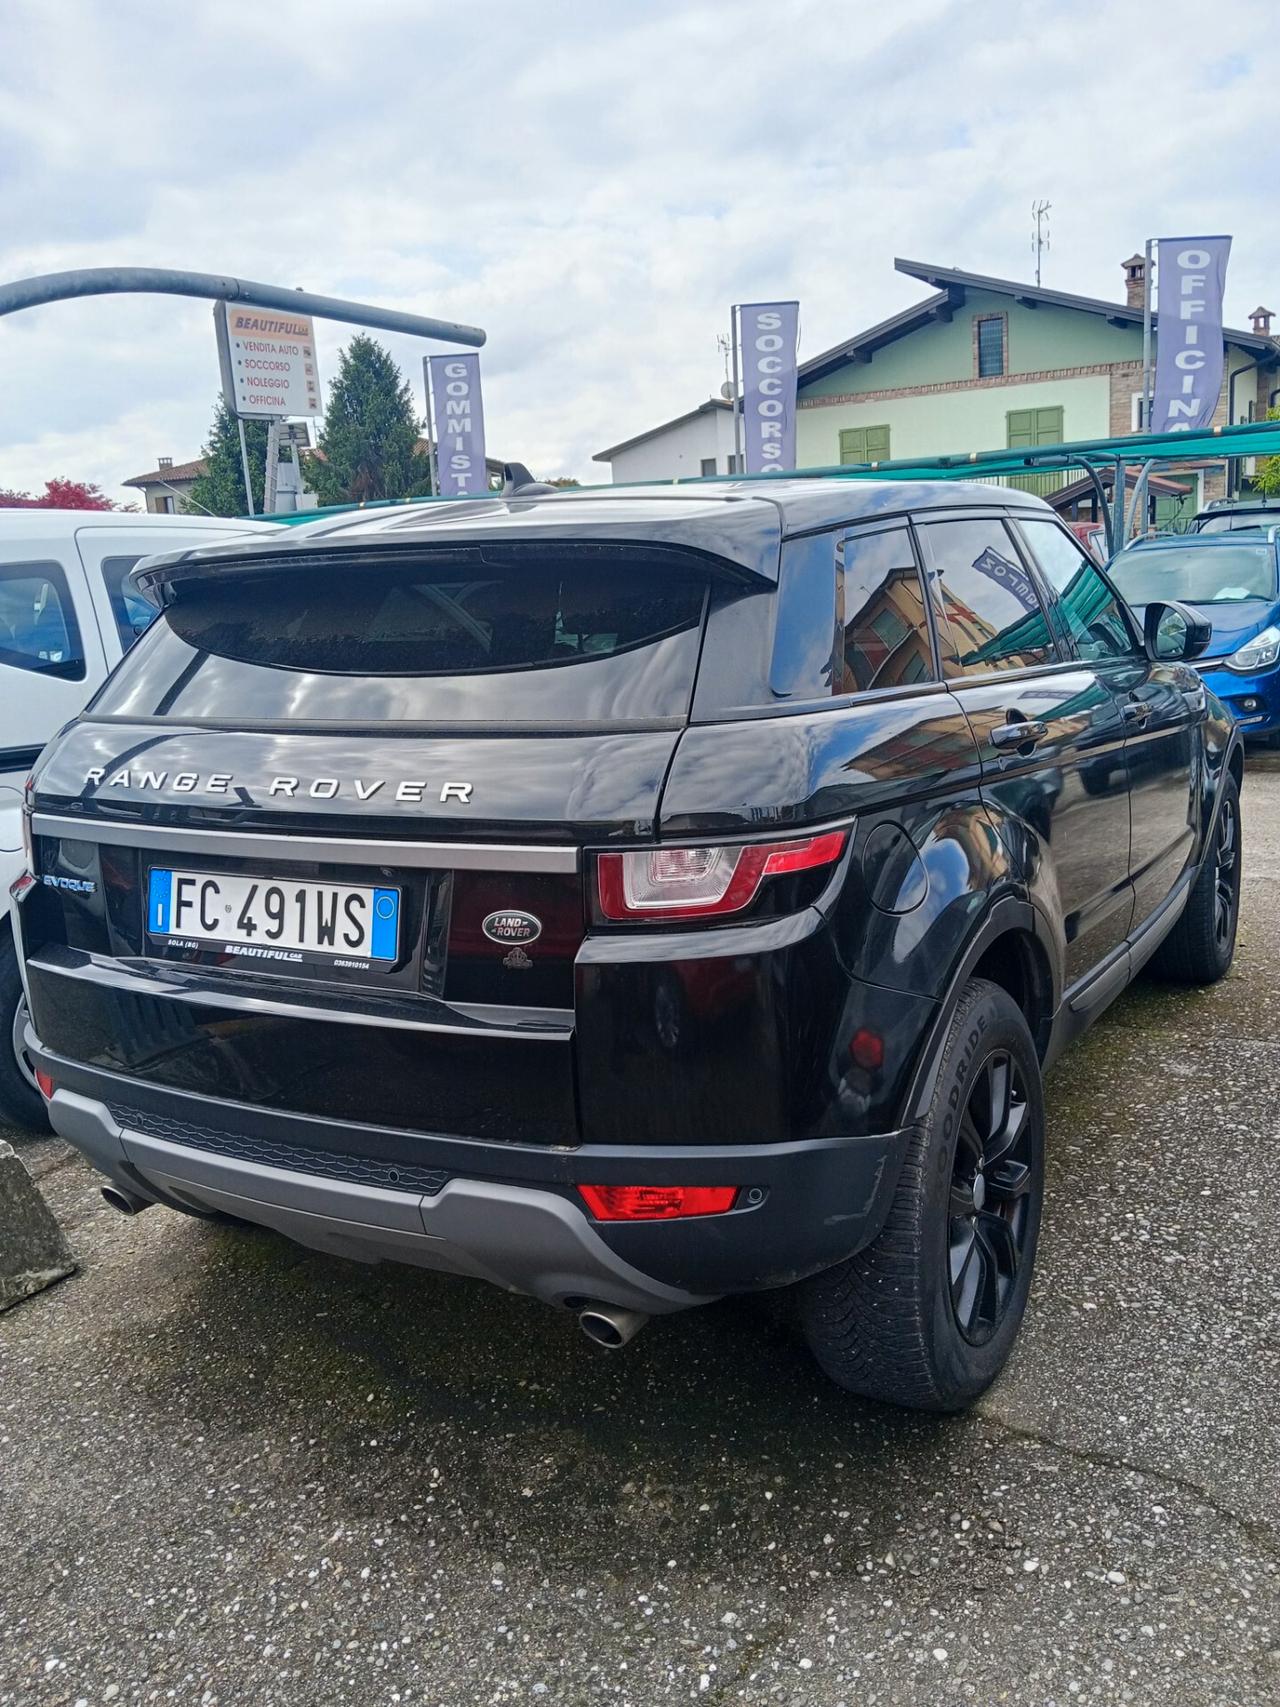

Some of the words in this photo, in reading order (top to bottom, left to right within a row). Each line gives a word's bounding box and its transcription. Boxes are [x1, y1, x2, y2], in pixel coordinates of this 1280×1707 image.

[235, 317, 298, 335] BEAUTIFUL
[243, 341, 276, 353] VENDITA
[278, 345, 299, 356] AUTO
[244, 358, 290, 372] SOCCORSO
[246, 377, 290, 389] NOLEGGIO
[248, 394, 286, 406] OFFICINA
[83, 768, 233, 794] RANGE
[268, 776, 474, 804] ROVER
[43, 875, 95, 892] EVOQUE
[175, 878, 220, 931] FC
[236, 884, 366, 948] 491WS
[494, 917, 521, 927] LAND
[496, 927, 531, 938] ROVER
[167, 939, 184, 947] SOLA
[224, 945, 289, 961] BEAUTIFUL
